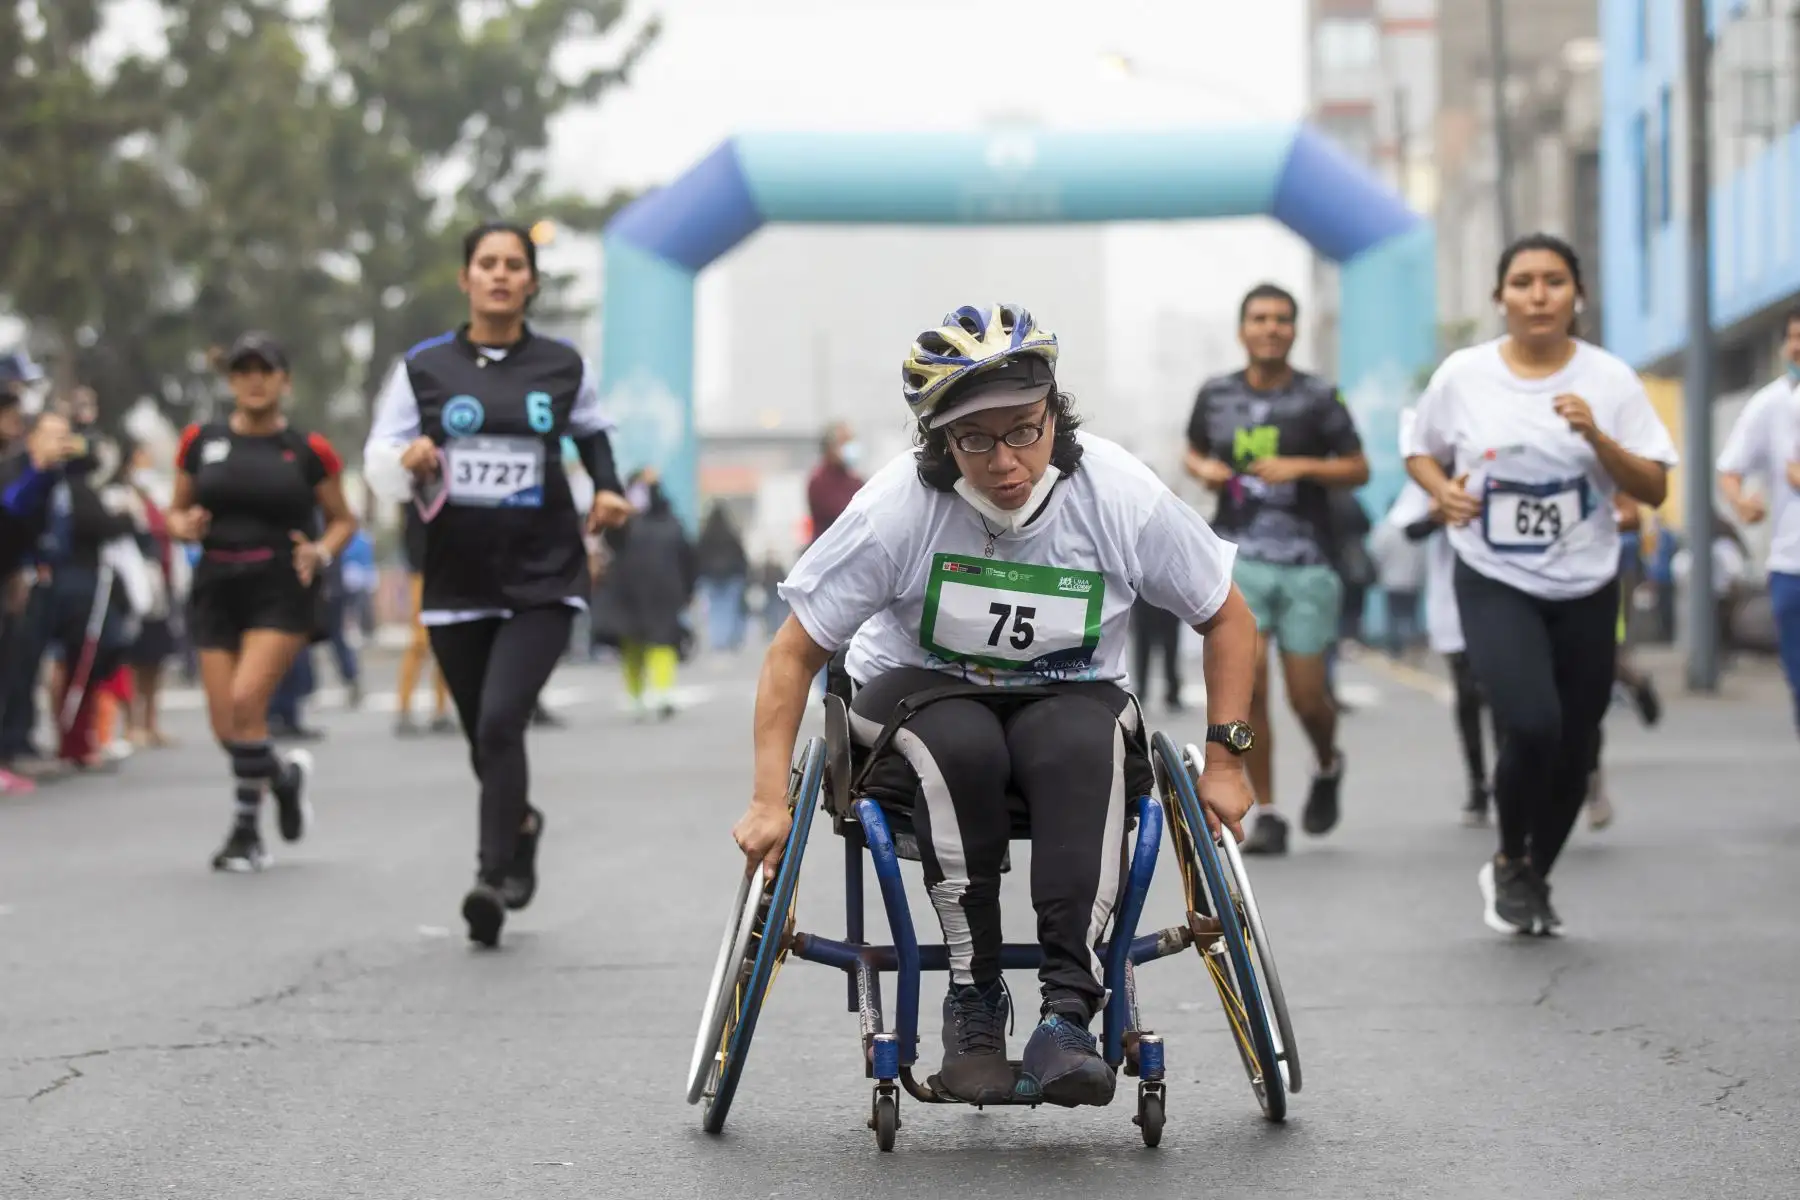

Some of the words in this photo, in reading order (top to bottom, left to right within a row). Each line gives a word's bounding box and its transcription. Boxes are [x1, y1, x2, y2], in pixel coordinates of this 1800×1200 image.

[526, 391, 553, 432] 6
[457, 462, 528, 486] 3727
[1516, 500, 1561, 536] 629
[987, 602, 1037, 650] 75
[1054, 660, 1086, 669] LIMA
